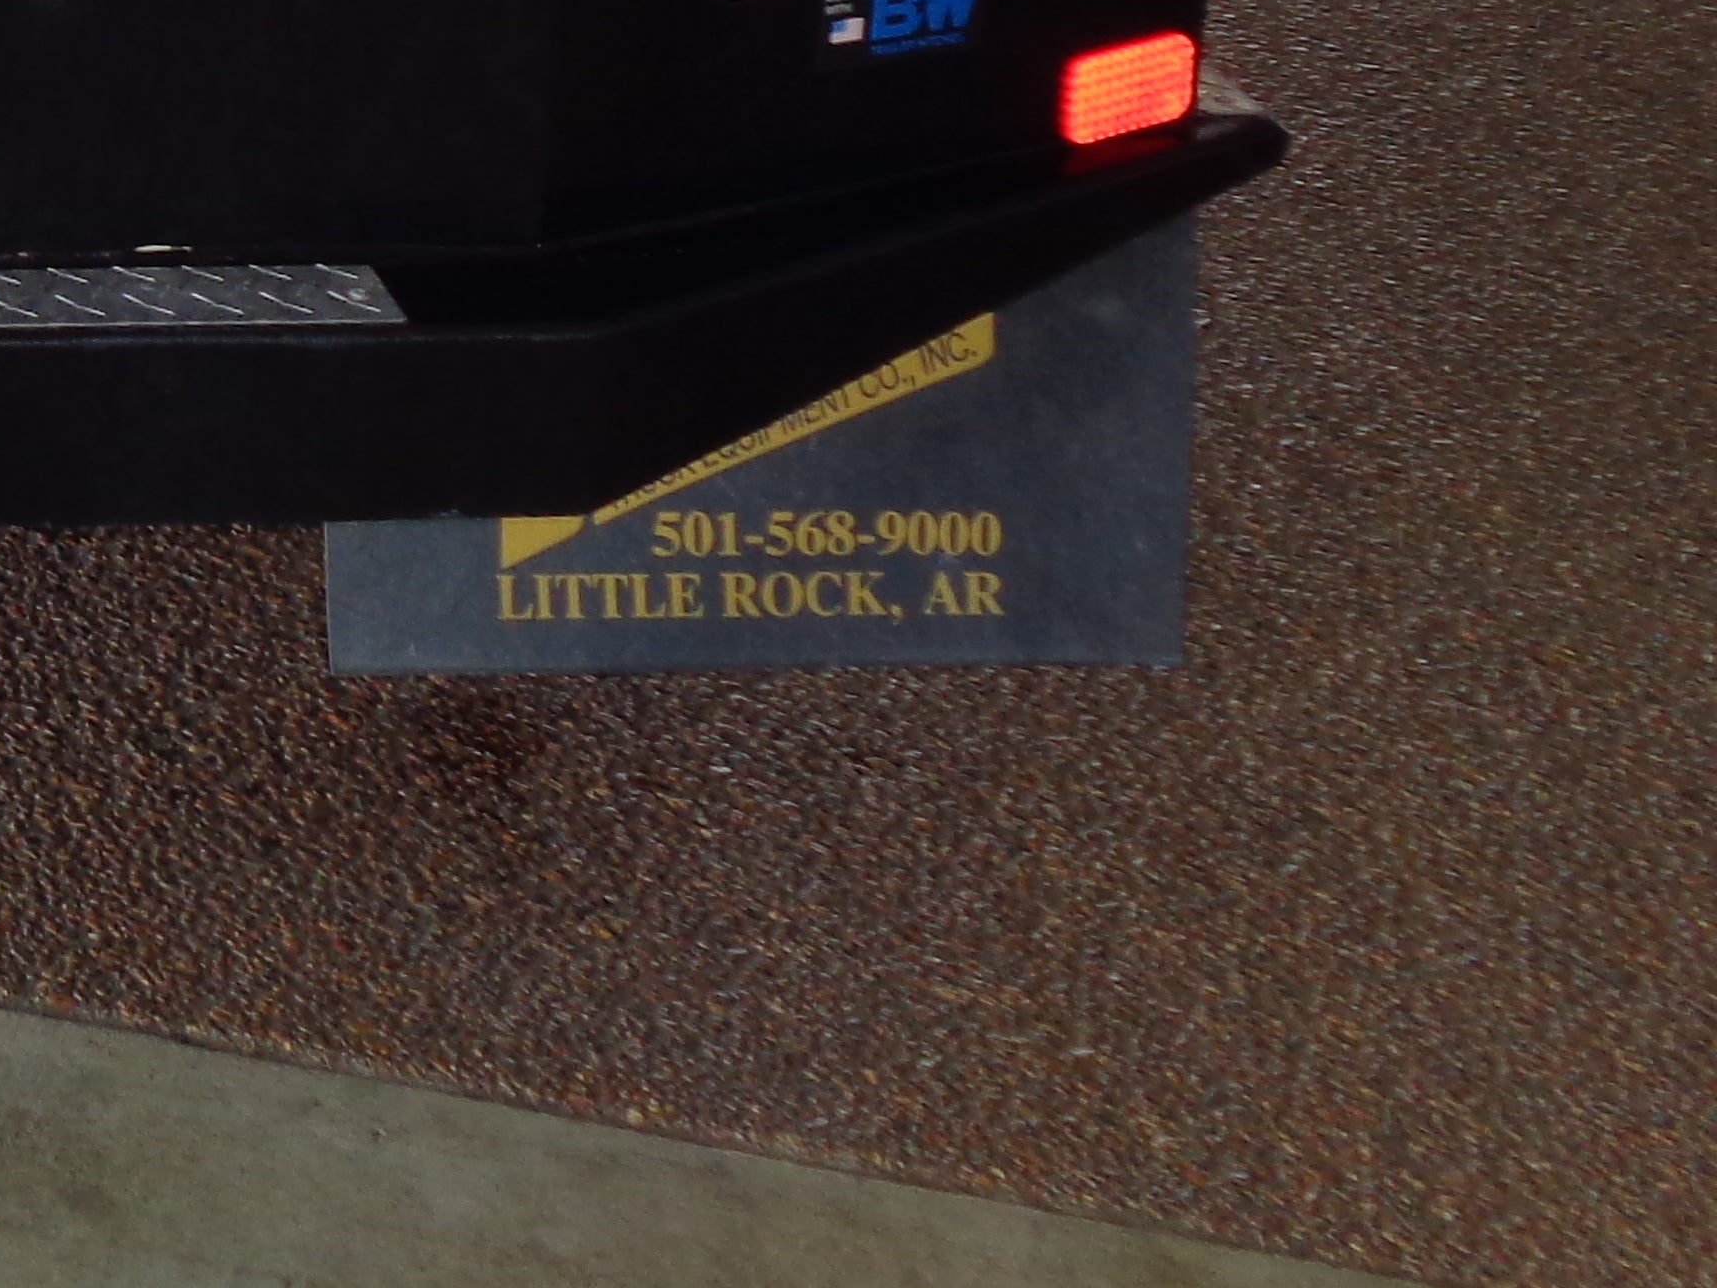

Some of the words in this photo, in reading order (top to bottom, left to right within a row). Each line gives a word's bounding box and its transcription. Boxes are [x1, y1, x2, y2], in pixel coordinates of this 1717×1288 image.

[652, 511, 1002, 559] 501-568-9000
[498, 573, 704, 621] LITTLE
[722, 573, 904, 627] ROCK,
[923, 572, 1005, 619] AR
